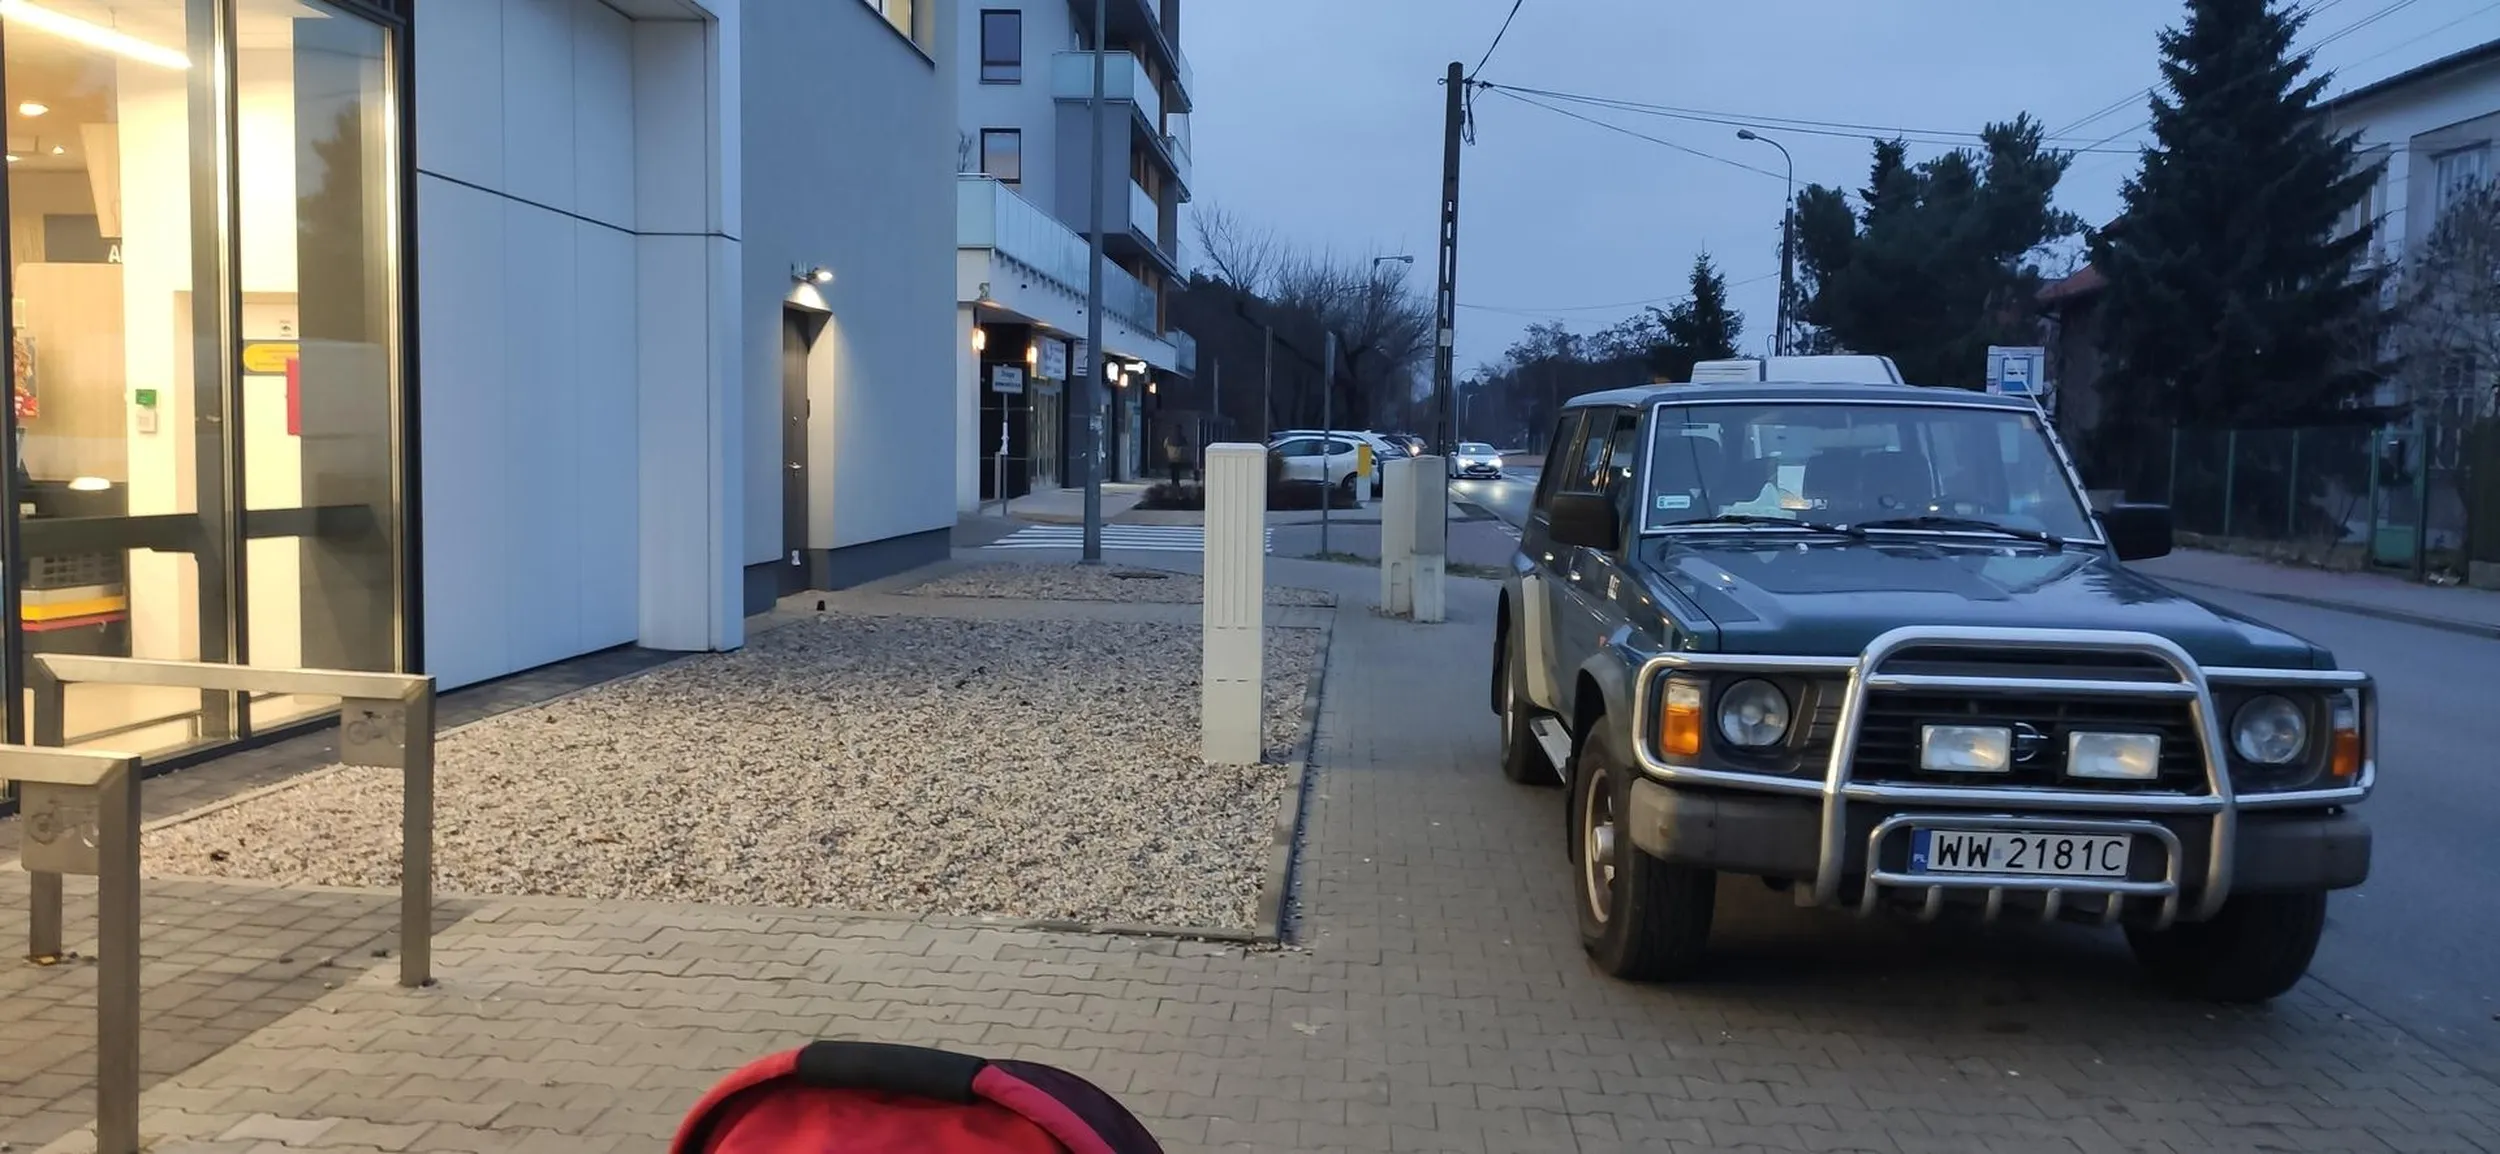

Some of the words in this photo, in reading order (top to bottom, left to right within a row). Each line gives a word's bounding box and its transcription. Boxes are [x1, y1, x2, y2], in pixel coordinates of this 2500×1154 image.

[1913, 853, 1927, 863] PL
[1938, 835, 1992, 868] WW
[2005, 837, 2124, 871] 2181C
